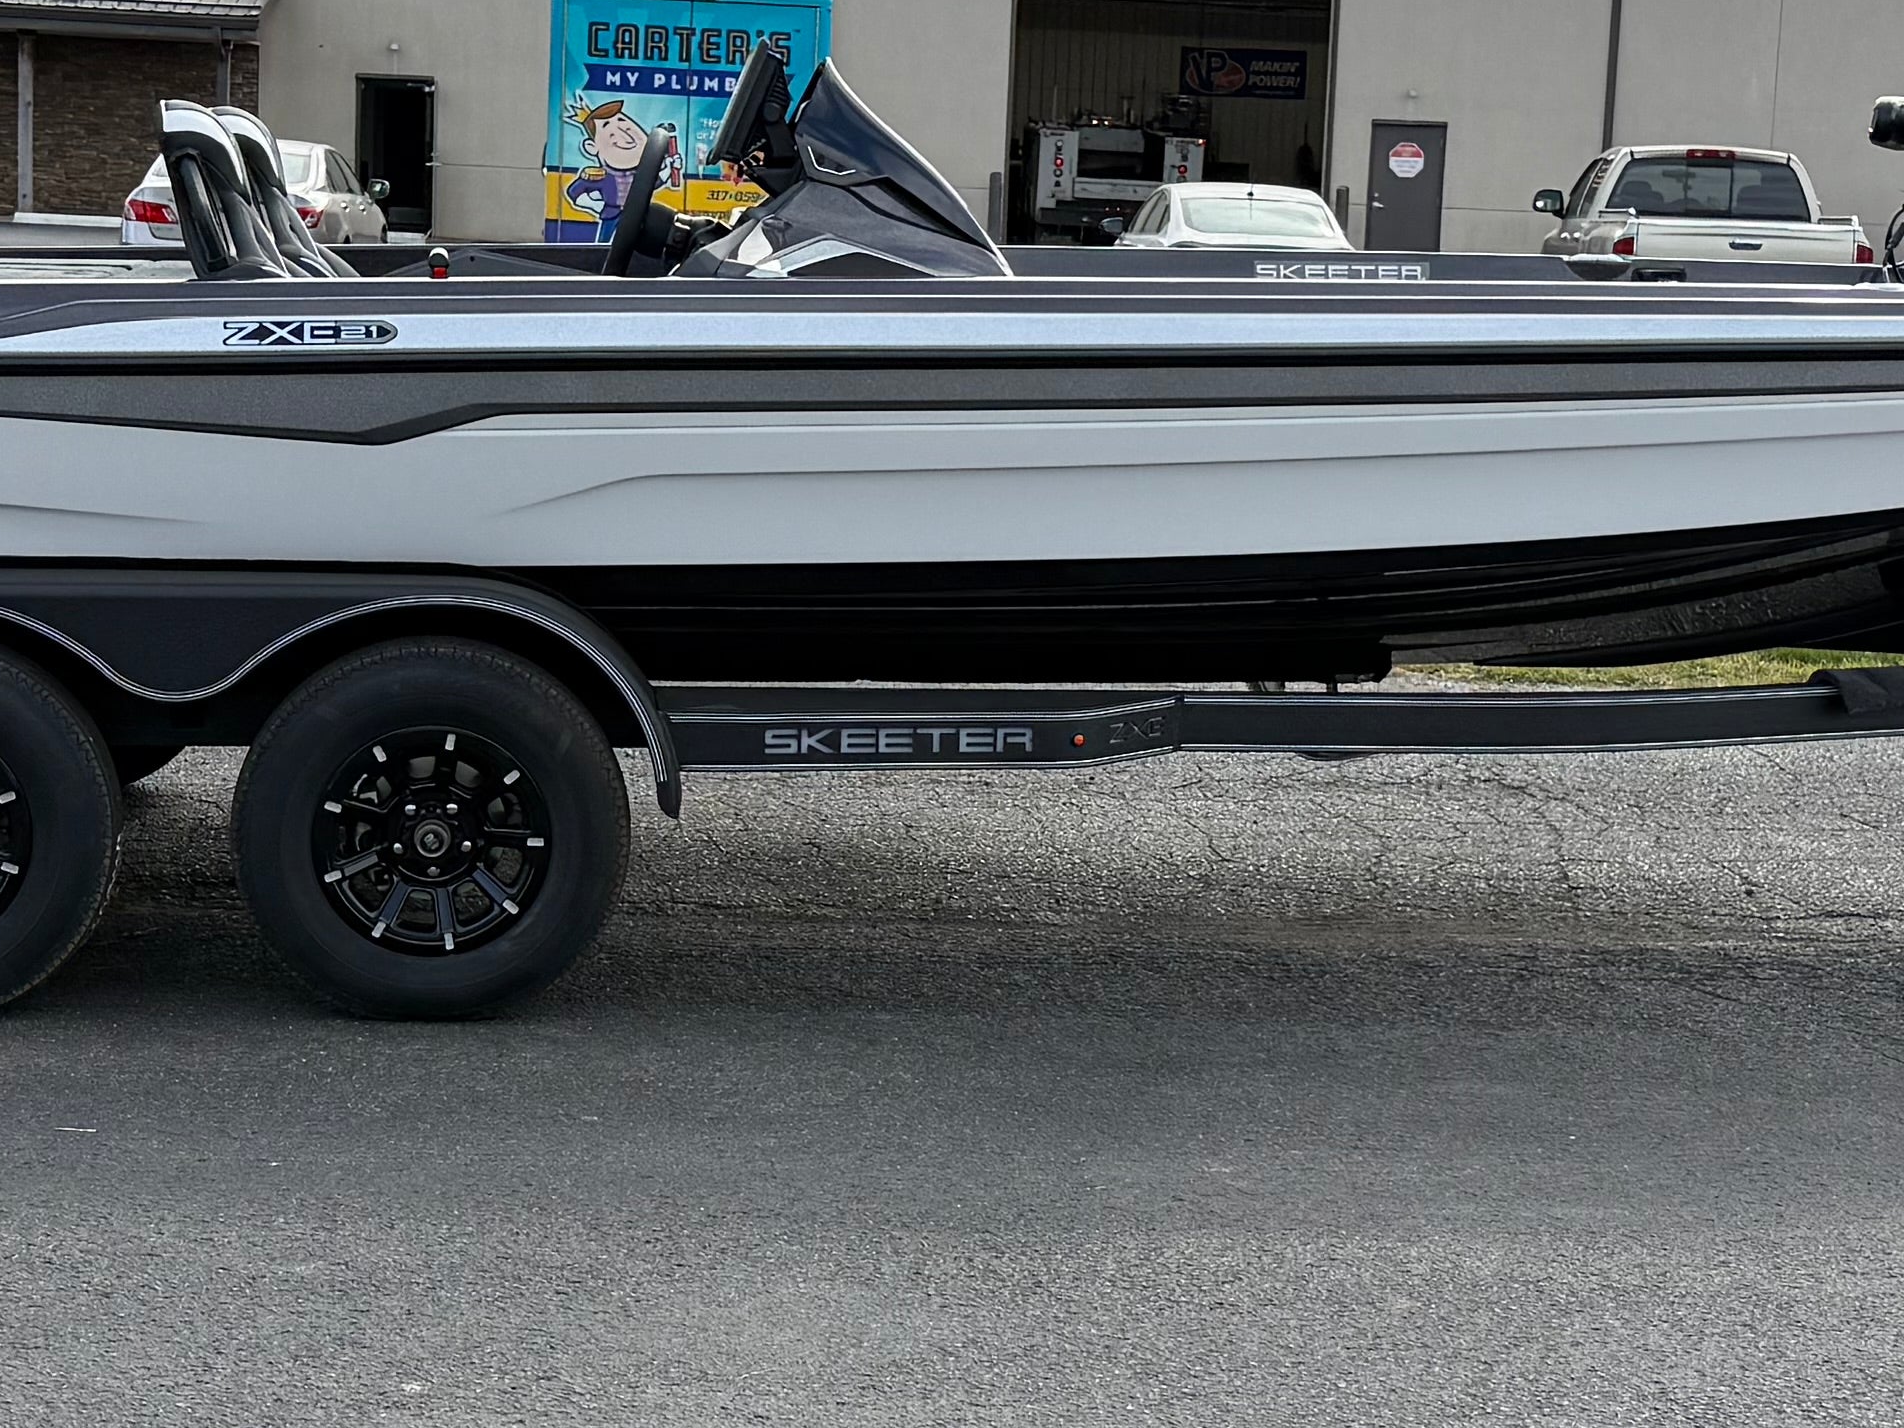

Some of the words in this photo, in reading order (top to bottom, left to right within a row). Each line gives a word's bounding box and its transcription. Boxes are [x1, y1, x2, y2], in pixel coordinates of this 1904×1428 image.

[606, 71, 640, 88] MY
[653, 75, 737, 93] PLUMB
[1248, 73, 1301, 88] POWER!
[1256, 264, 1422, 280] SKEETER
[764, 727, 1033, 754] SKEETER
[1109, 717, 1163, 744] ZXE
